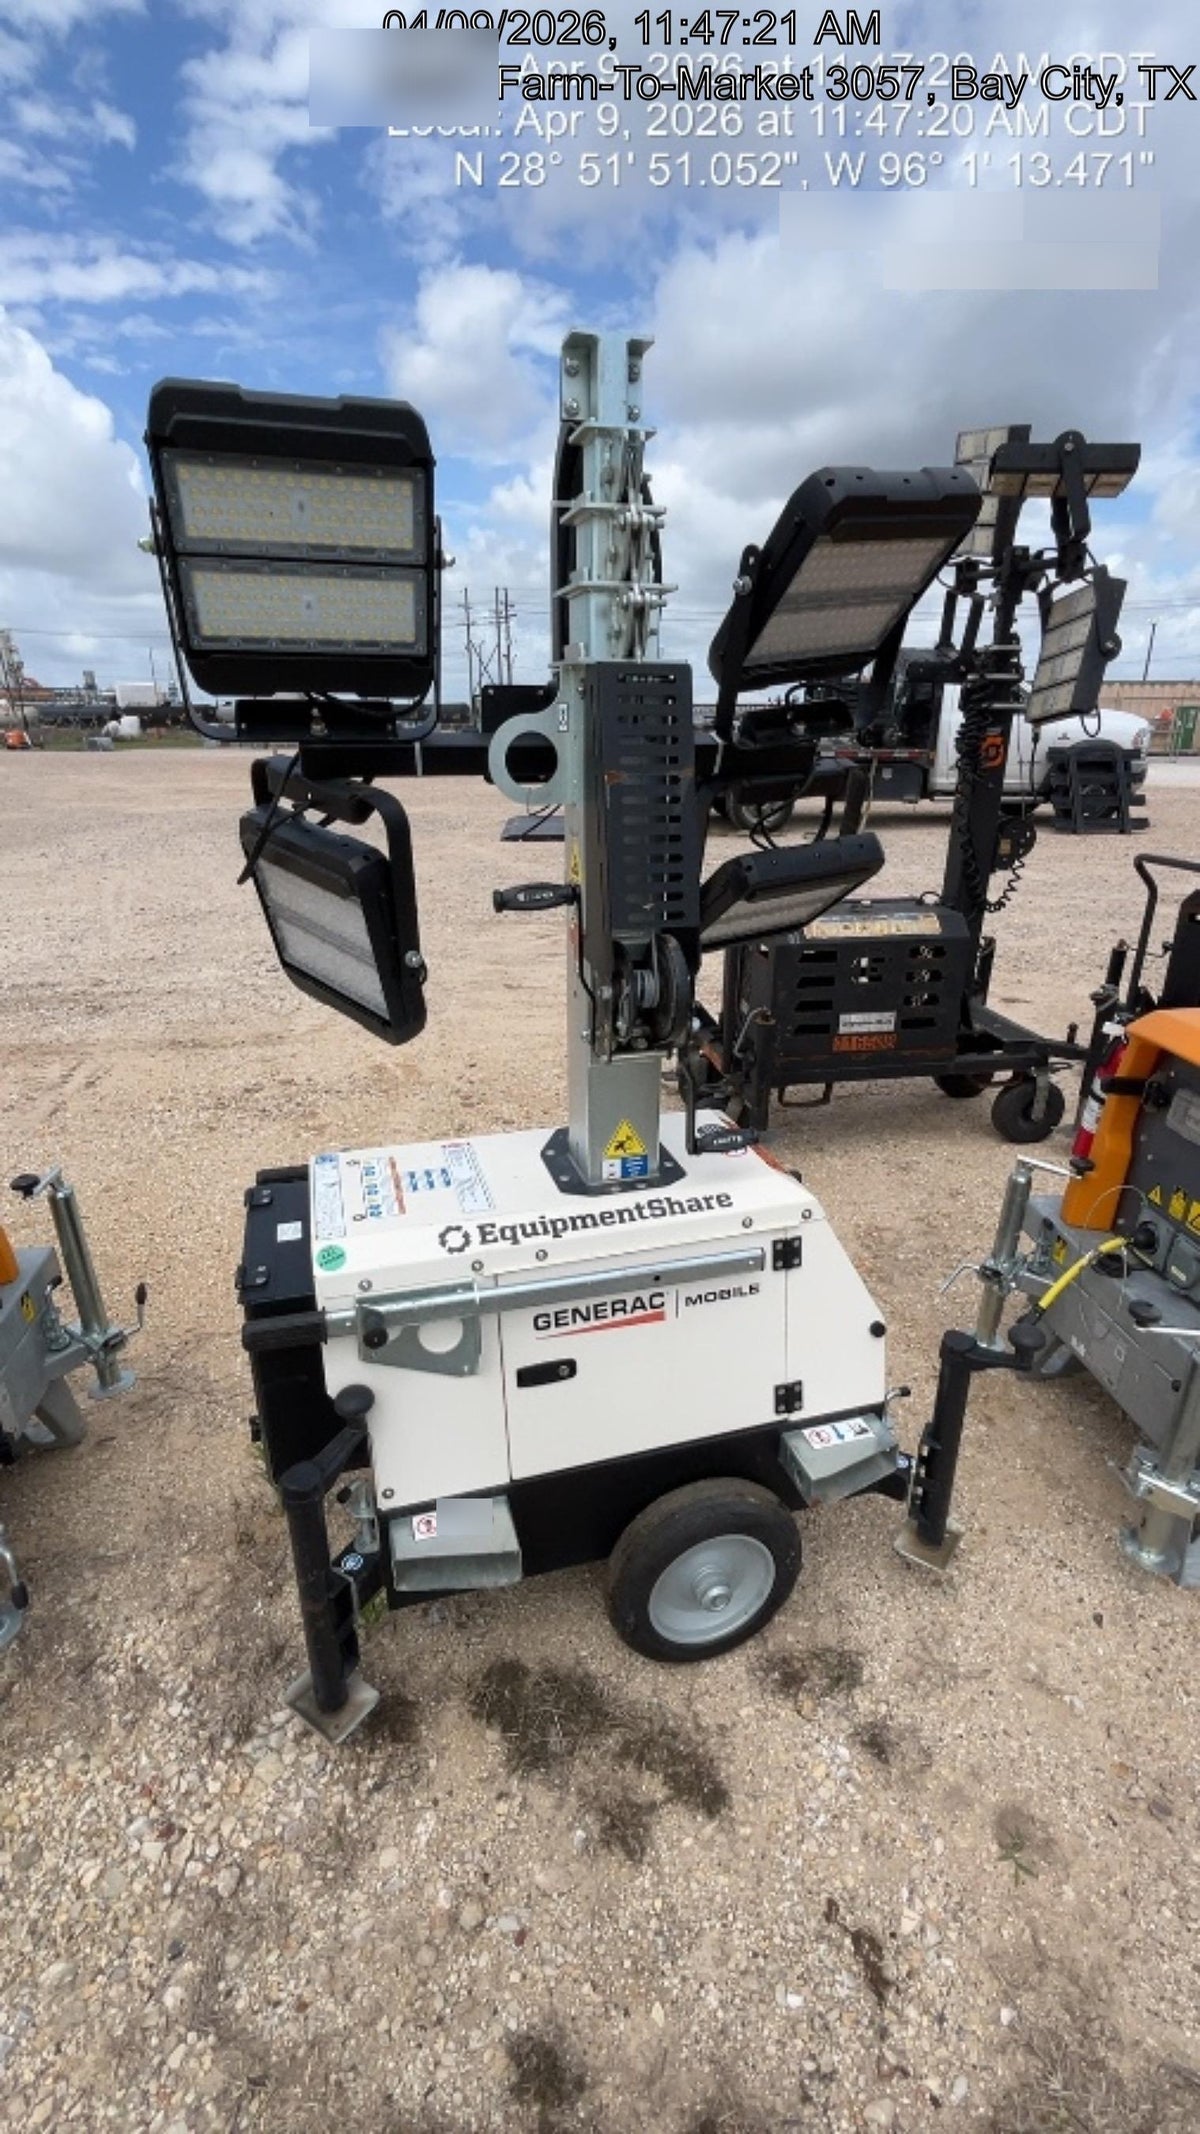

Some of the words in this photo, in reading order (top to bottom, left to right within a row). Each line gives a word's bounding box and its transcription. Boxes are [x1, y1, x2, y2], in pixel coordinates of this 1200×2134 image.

[477, 1192, 734, 1246] EquipmentShare
[533, 1291, 665, 1331] GENERAC
[685, 1282, 760, 1307] MOBILE
